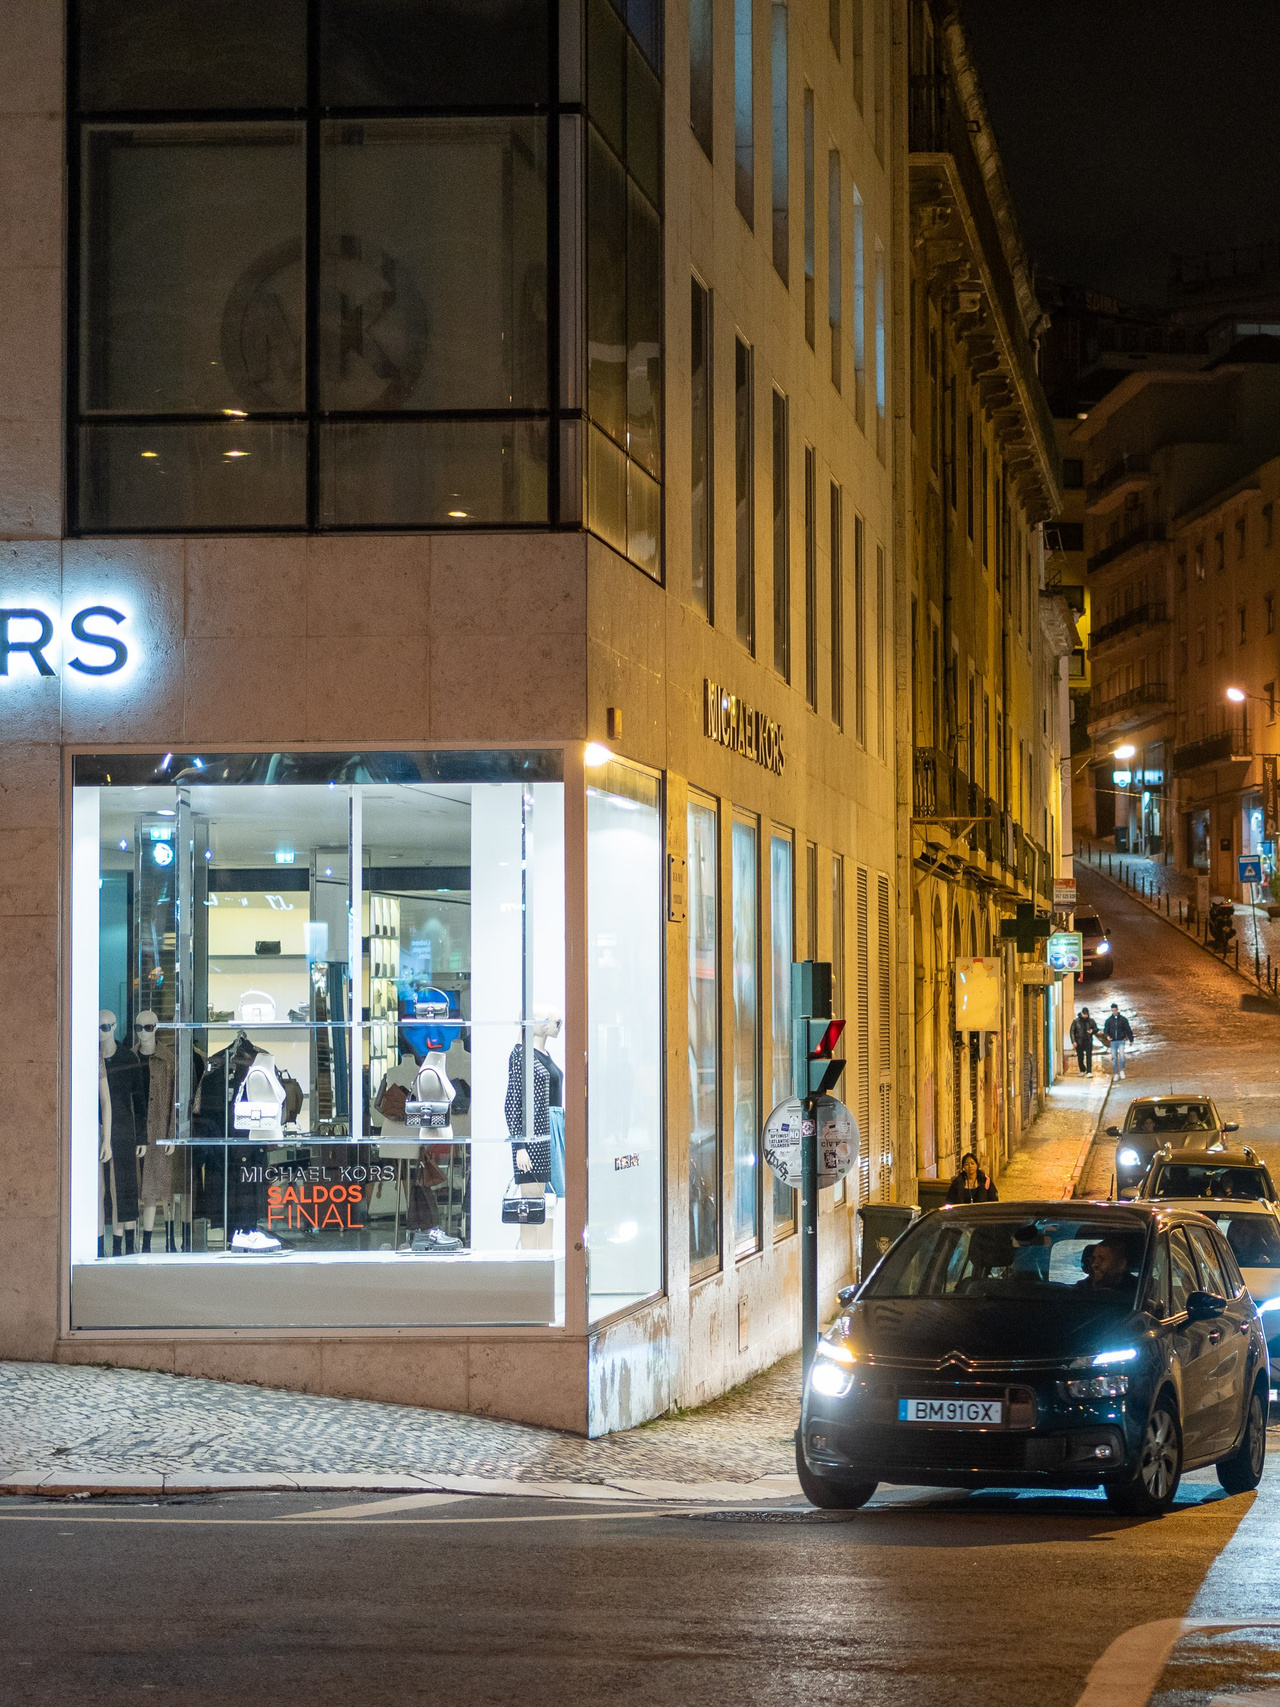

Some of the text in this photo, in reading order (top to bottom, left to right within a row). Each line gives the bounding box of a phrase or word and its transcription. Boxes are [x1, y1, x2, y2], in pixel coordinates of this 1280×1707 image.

[703, 678, 785, 776] MICHAEL KORS
[241, 1165, 395, 1183] MICHAEL KORS
[267, 1184, 363, 1204] SALDOS
[268, 1203, 364, 1229] FINAL
